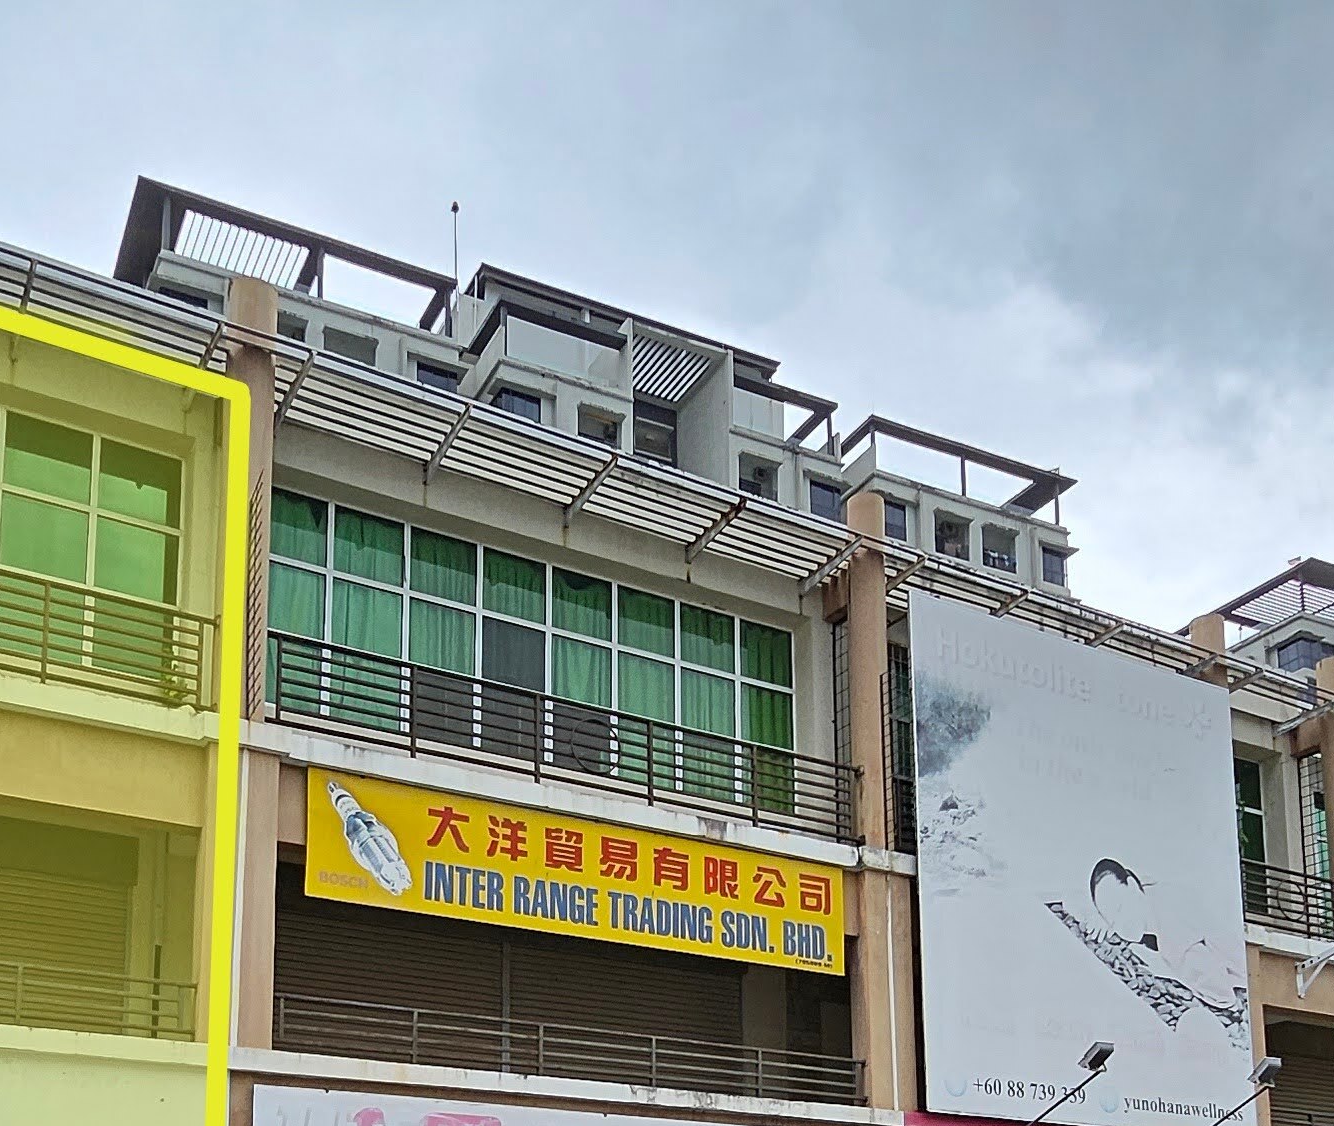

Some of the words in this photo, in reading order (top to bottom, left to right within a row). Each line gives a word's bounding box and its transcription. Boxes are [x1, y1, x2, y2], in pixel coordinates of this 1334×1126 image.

[427, 806, 831, 915] 大洋貿易有限公司
[424, 861, 504, 912] INTER
[513, 876, 599, 926] RANGE
[608, 890, 713, 943] TRADING
[721, 910, 775, 953] SDN.
[783, 920, 833, 962] BHD.
[973, 1078, 1002, 1095] +60
[1006, 1080, 1025, 1098] 88
[1030, 1083, 1056, 1101] 739
[1123, 1096, 1244, 1122] yunohanawellness
